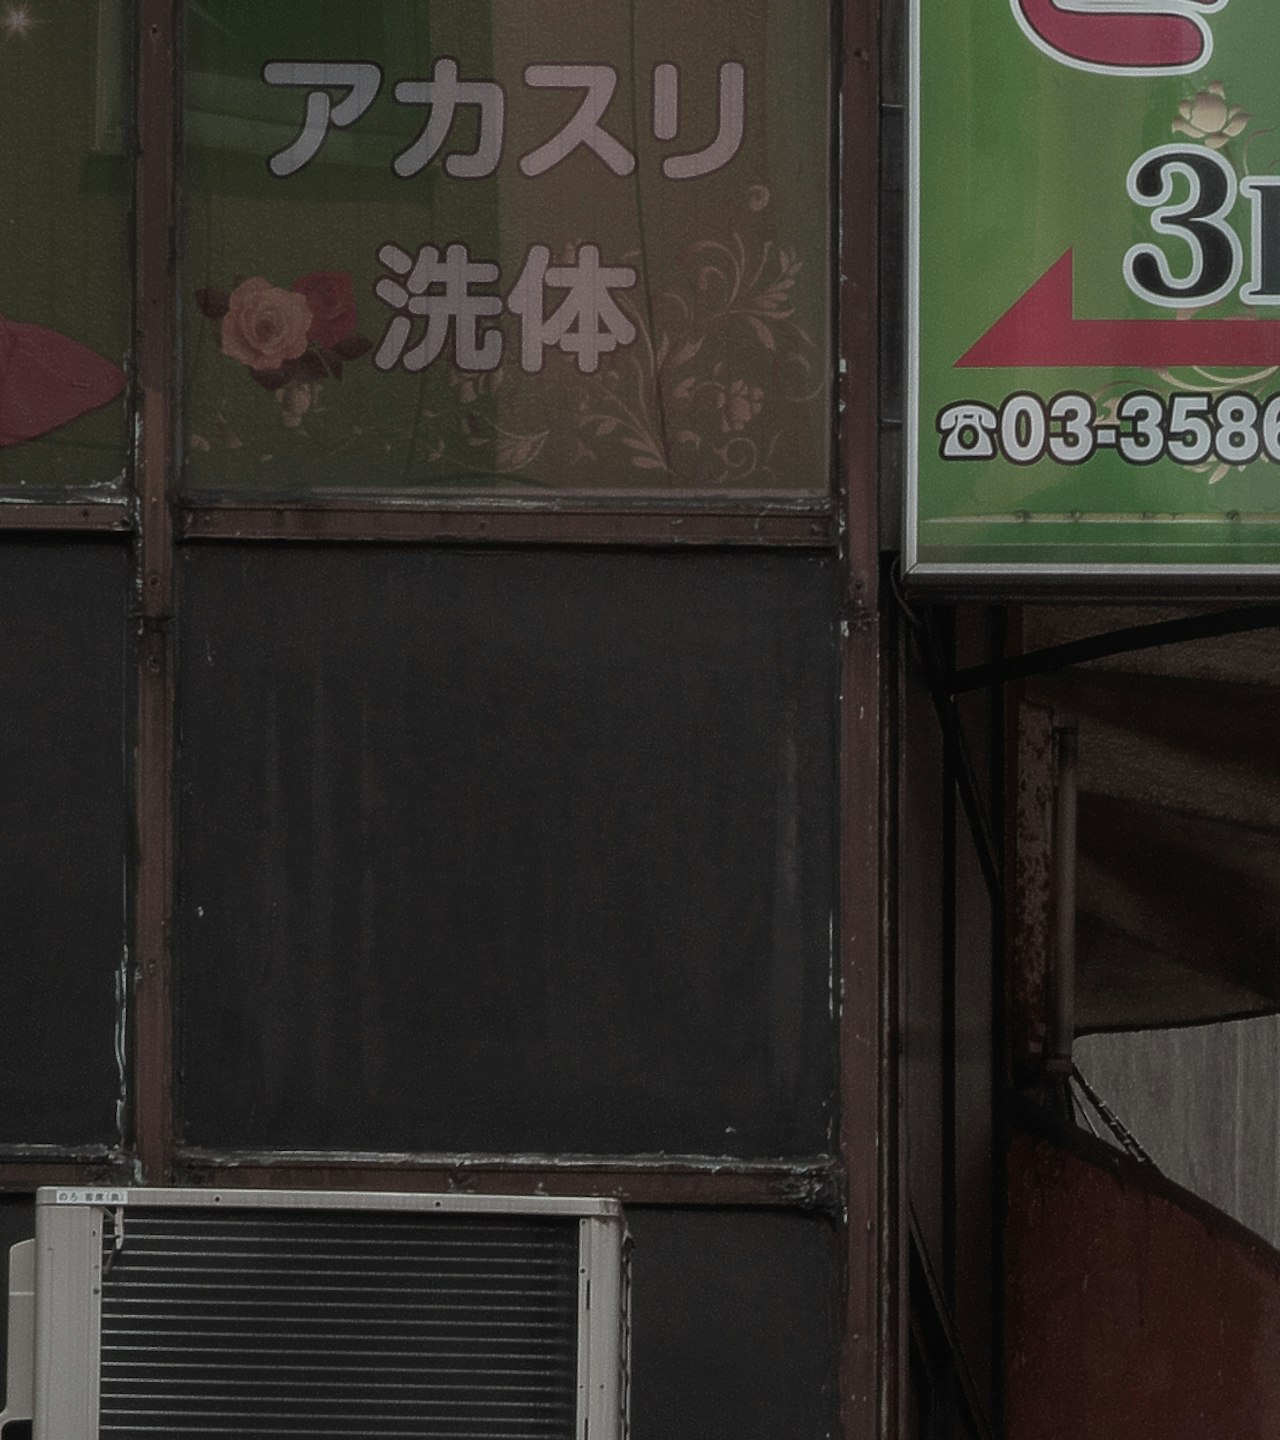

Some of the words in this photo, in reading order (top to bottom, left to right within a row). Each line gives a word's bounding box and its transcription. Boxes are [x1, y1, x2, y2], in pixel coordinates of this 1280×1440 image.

[263, 58, 746, 180] アカスリ
[373, 243, 638, 373] 洗体
